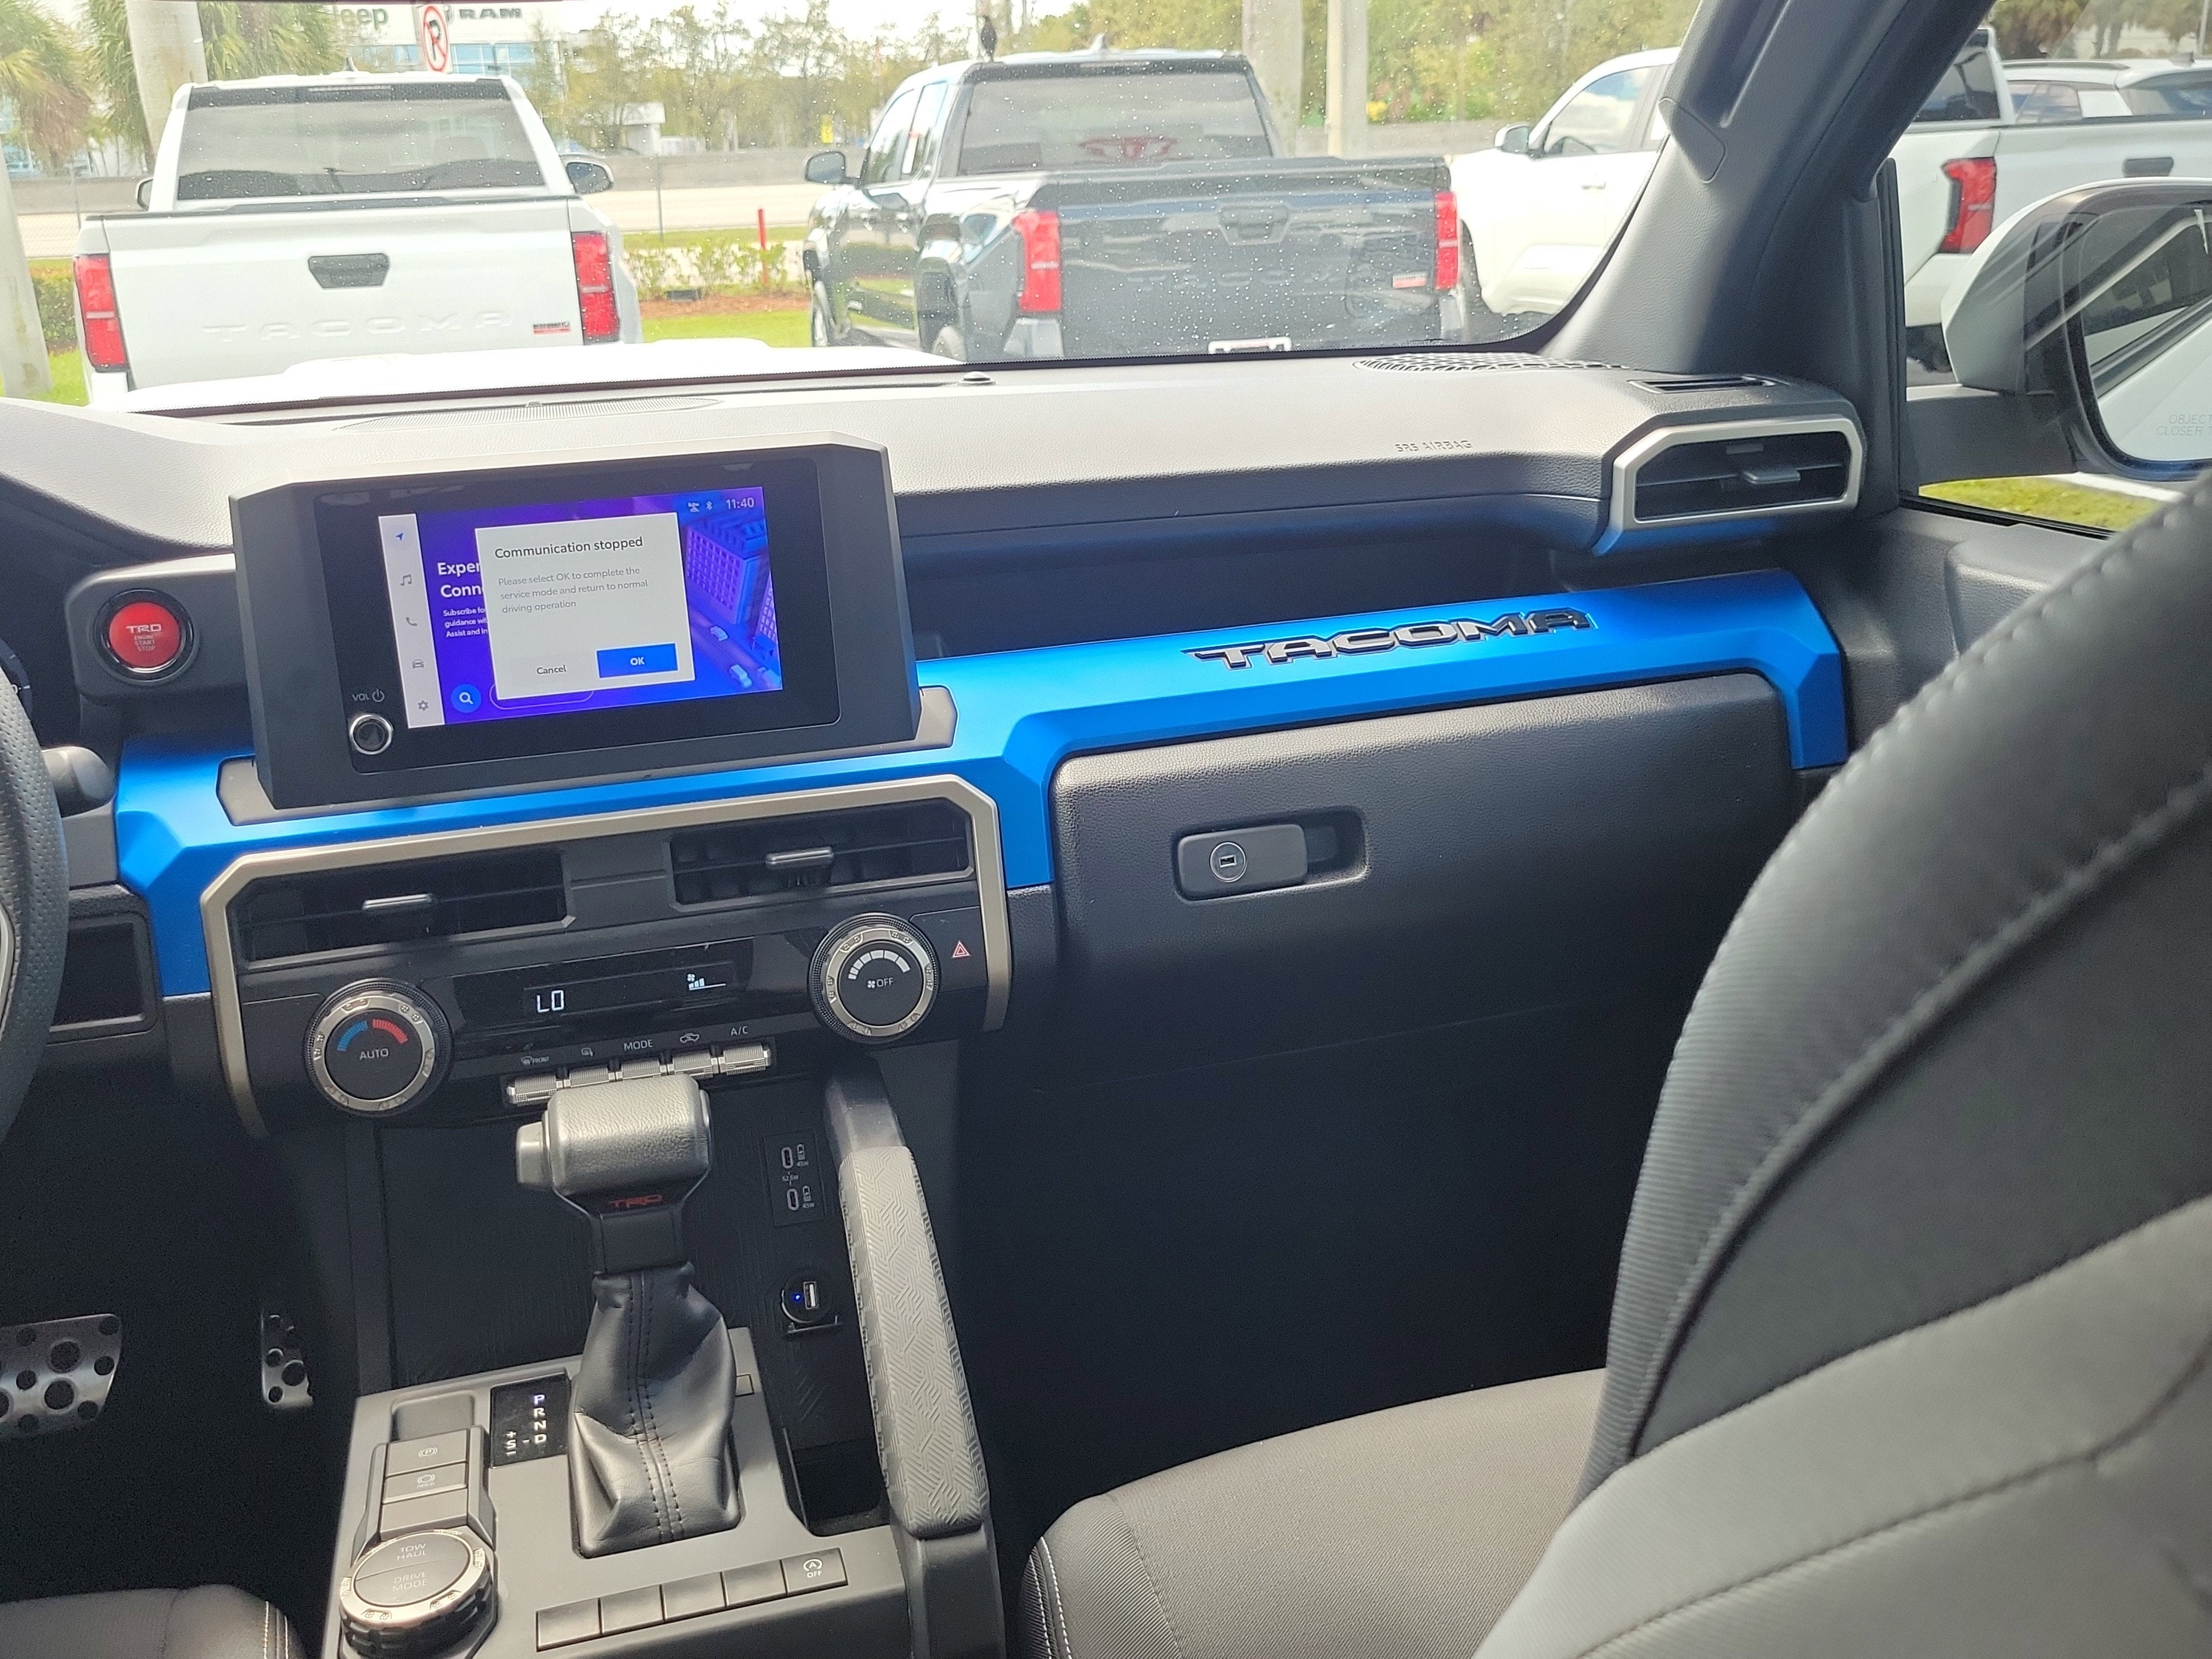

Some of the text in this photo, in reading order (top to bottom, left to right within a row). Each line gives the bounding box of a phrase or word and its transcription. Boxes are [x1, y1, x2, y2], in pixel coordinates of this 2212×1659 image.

[459, 8, 522, 19] RAM
[202, 311, 512, 342] TACOMA
[2156, 426, 2203, 436] CLOSER
[1395, 440, 1473, 452] SRS AIRBAG
[726, 497, 755, 510] 11:40
[494, 536, 644, 558] Communication stopped
[498, 577, 527, 586] Please
[528, 574, 554, 584] select
[556, 572, 571, 582] OK
[583, 568, 624, 579] complete
[625, 567, 641, 575] the
[440, 584, 483, 599] Conn
[500, 591, 531, 600] service
[532, 587, 558, 597] mode
[560, 585, 577, 595] and
[578, 584, 605, 593] return
[617, 579, 648, 590] normal
[443, 608, 477, 617] Subscribe
[501, 600, 577, 614] driving operation
[126, 623, 162, 634] TRD
[444, 619, 477, 629] guidance
[1188, 607, 1594, 669] TACOMA
[630, 656, 645, 666] OK
[537, 664, 567, 675] Cancel
[352, 693, 370, 701] VOL
[876, 977, 894, 988] OFF
[537, 989, 565, 1013] LO
[730, 1026, 749, 1036] A/C
[624, 1039, 653, 1052] MODE
[359, 1048, 389, 1060] AUTO
[609, 1194, 663, 1208] TRD
[534, 1394, 545, 1406] P
[534, 1407, 546, 1418] R
[534, 1420, 546, 1431] N
[535, 1434, 547, 1444] D
[400, 1543, 426, 1553] TOW
[397, 1549, 426, 1561] HAUL
[394, 1571, 427, 1584] DRIVE
[807, 1570, 822, 1578] OFF
[393, 1579, 428, 1593] MODE
